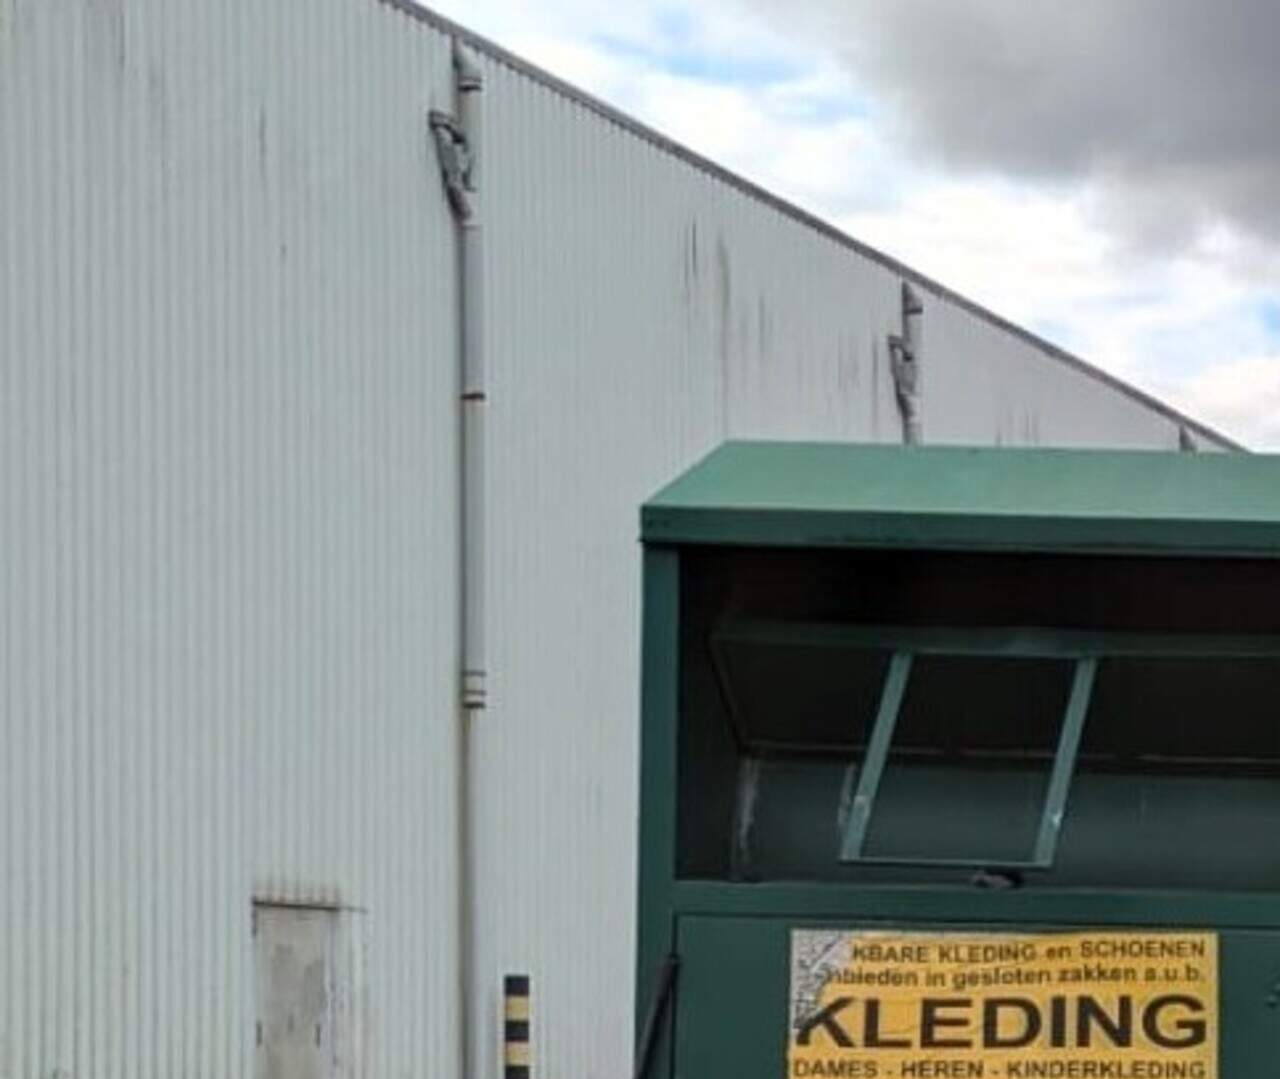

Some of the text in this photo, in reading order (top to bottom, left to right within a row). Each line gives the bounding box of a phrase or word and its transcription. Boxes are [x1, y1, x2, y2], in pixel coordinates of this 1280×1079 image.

[939, 943, 1037, 962] KLEDING
[1045, 946, 1072, 959] en
[1080, 940, 1205, 959] SCHOENEN
[926, 968, 945, 987] in
[952, 966, 1051, 990] gesloten
[1058, 964, 1137, 983] zakken
[795, 994, 1207, 1049] KLEDING
[793, 1059, 1207, 1079] DAMES HEREN KINDERKLEDING
